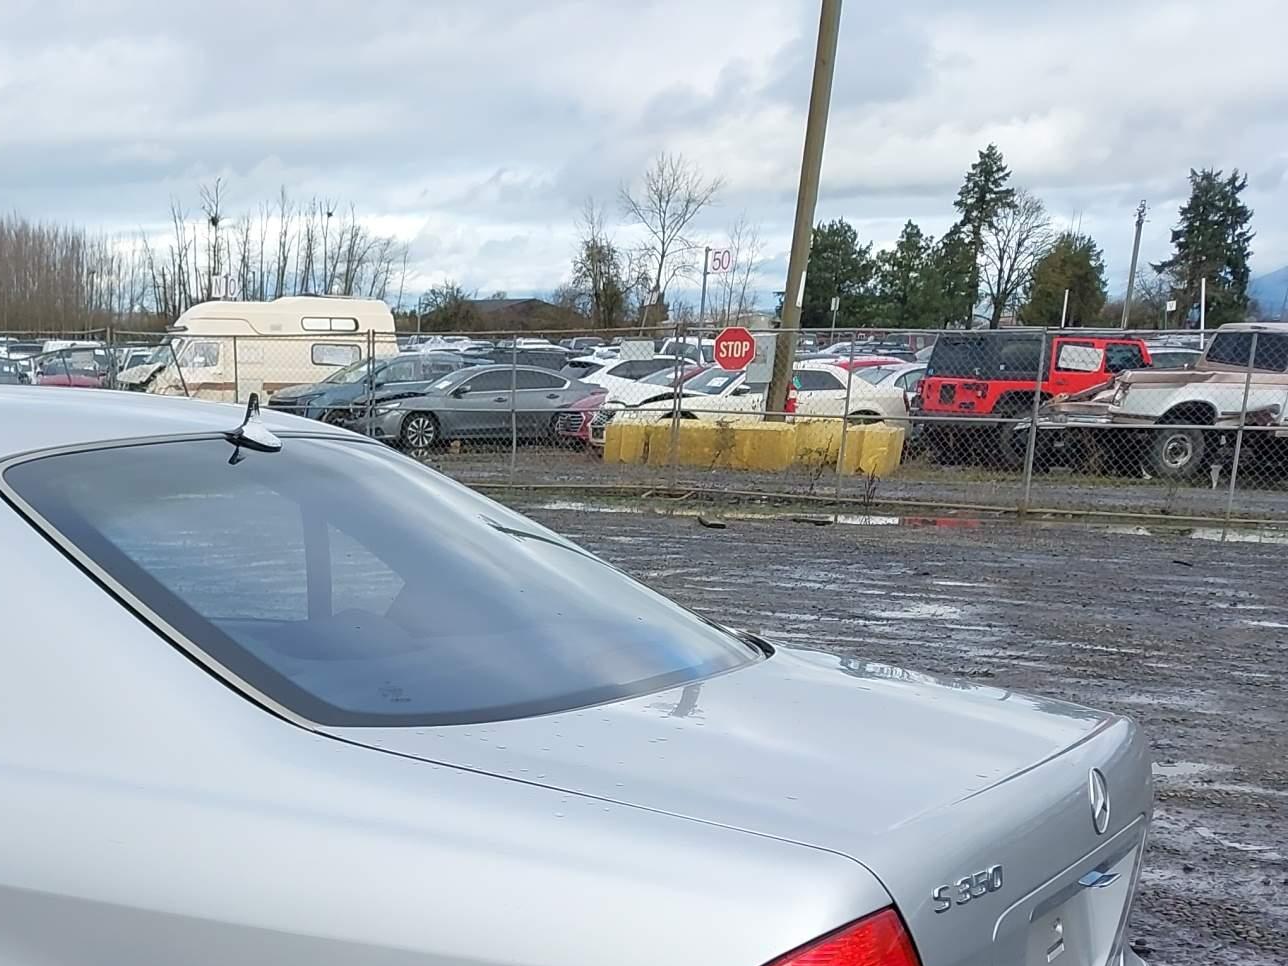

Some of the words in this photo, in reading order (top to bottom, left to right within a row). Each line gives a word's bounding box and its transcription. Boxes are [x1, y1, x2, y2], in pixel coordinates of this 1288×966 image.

[712, 250, 730, 271] 50
[719, 341, 750, 358] STOP
[932, 884, 951, 914] S
[954, 864, 1003, 906] 350
